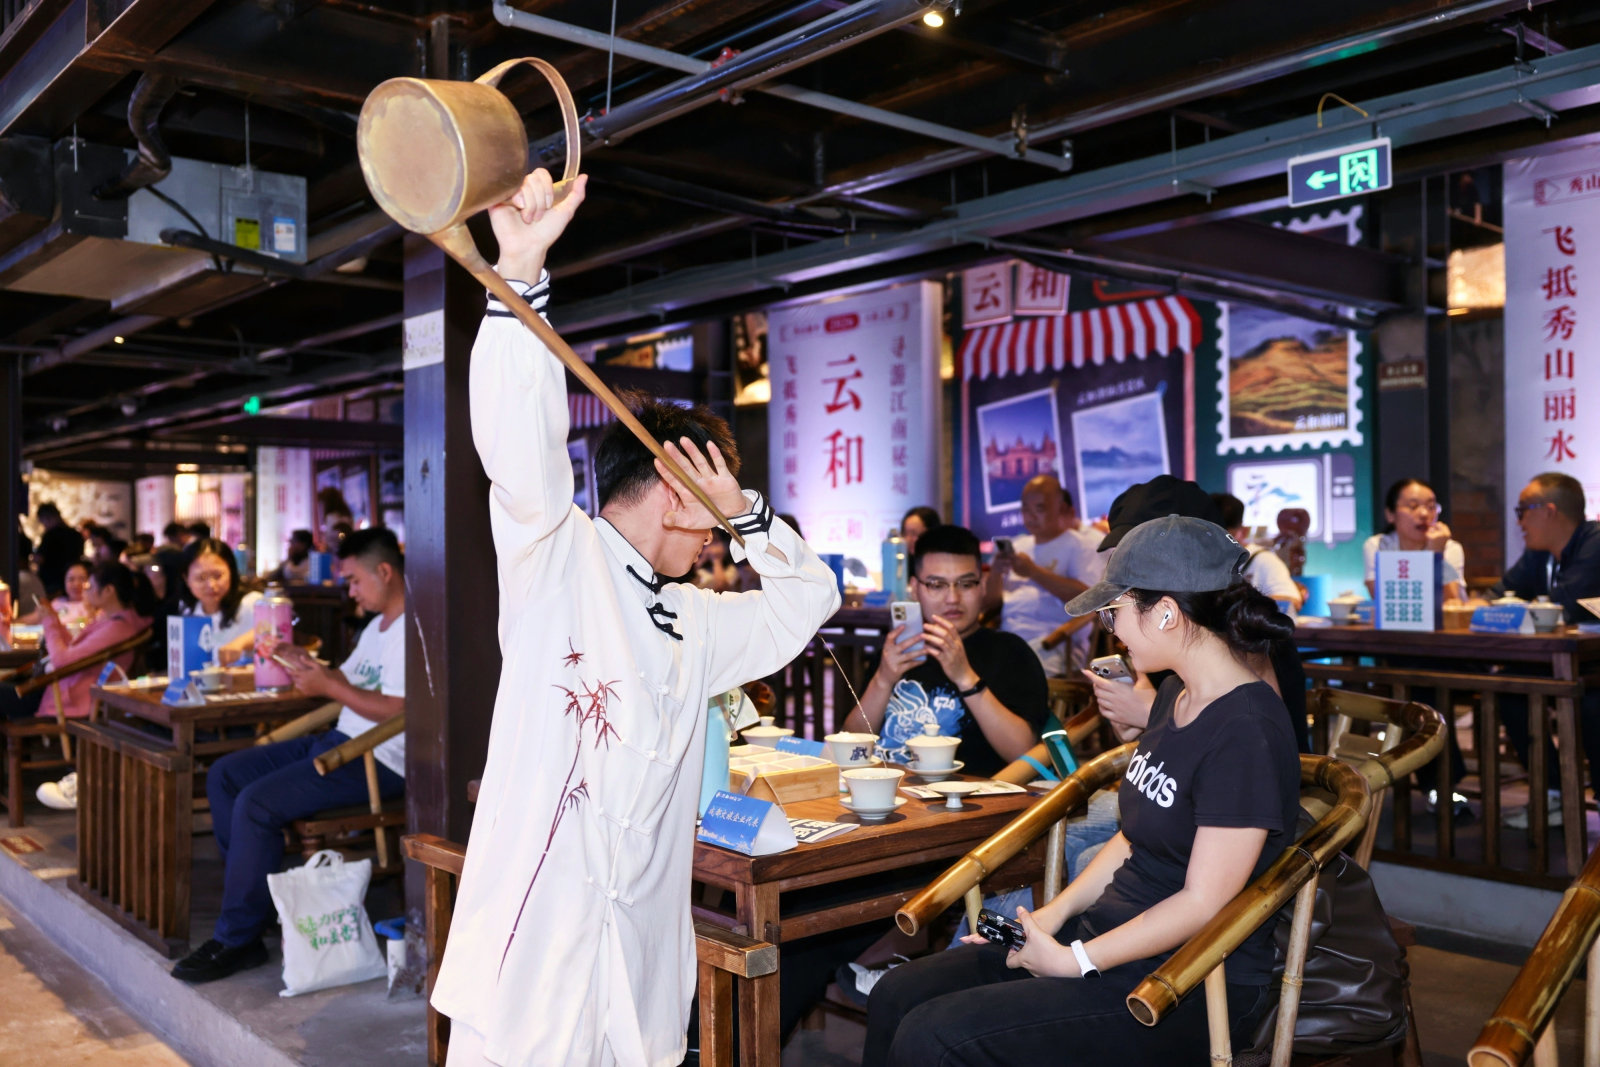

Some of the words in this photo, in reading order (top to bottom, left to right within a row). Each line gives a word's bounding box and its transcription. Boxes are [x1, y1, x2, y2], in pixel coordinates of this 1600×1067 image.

[972, 267, 1058, 312] 云和
[1541, 226, 1577, 463] 飞抵秀山丽水
[821, 354, 864, 488] 云和
[1126, 747, 1177, 808] didas
[708, 806, 759, 828] 成都文旅企业代表
